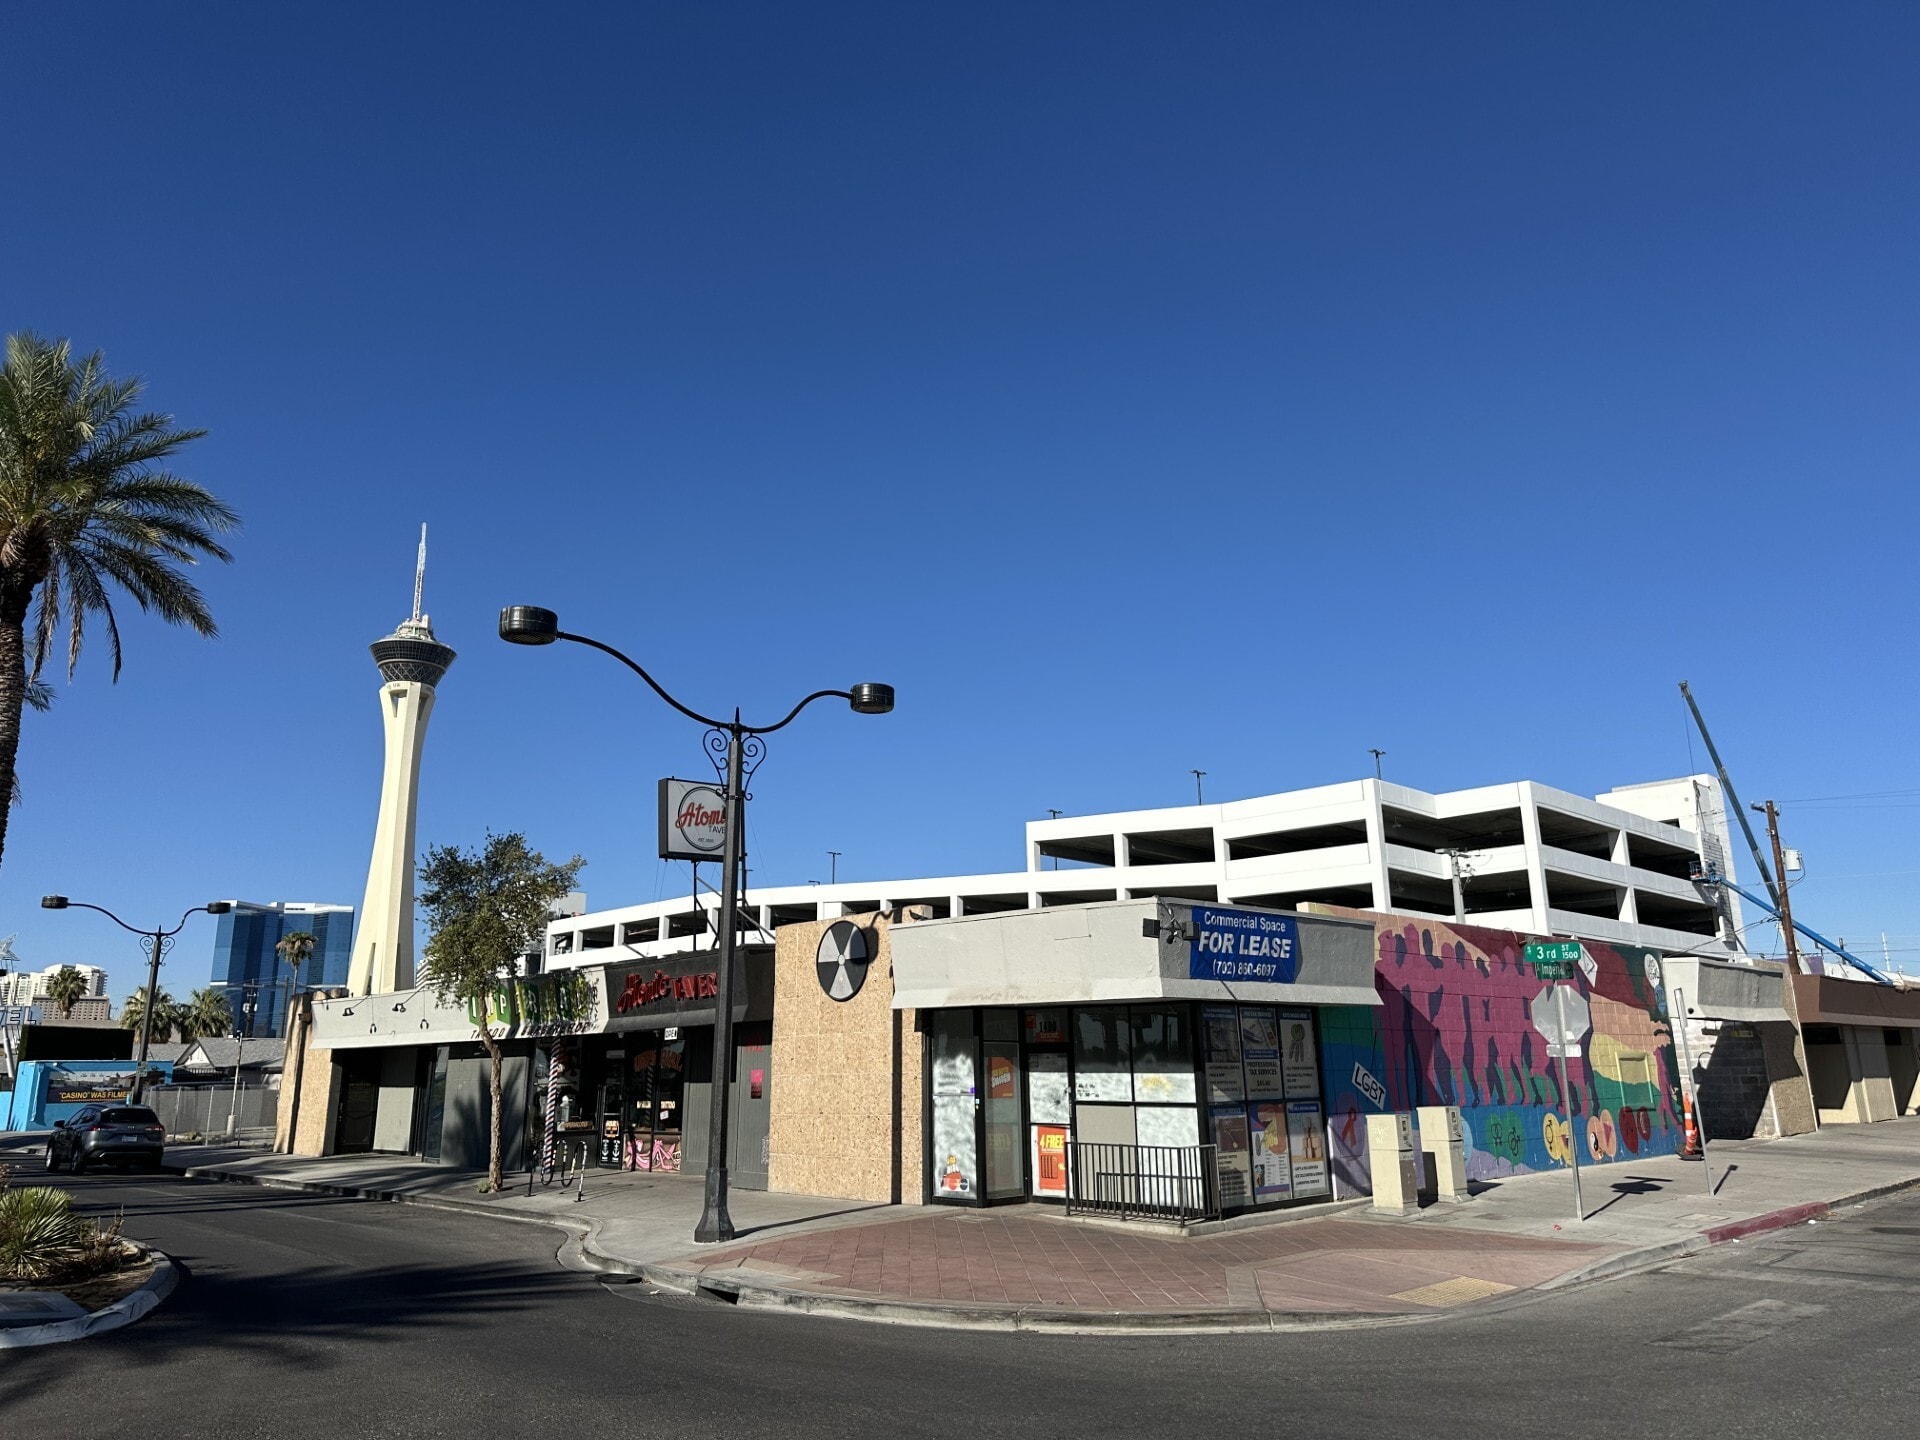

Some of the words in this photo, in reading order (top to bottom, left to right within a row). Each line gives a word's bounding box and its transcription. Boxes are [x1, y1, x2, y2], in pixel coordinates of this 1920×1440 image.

[675, 802, 727, 830] Atomi
[708, 826, 726, 834] TAVE
[1204, 911, 1258, 929] Commercial
[1259, 917, 1286, 933] Space
[1198, 930, 1235, 954] FOR
[1238, 934, 1292, 959] LEASE
[1526, 946, 1532, 954] S
[1561, 944, 1569, 952] ST
[1562, 951, 1579, 959] 1500
[1212, 959, 1236, 978] (702)
[671, 972, 718, 1000] TAVER
[1354, 1066, 1385, 1104] LGBT
[59, 1091, 90, 1099] "CASINO"
[91, 1091, 107, 1099] WAS
[108, 1091, 130, 1099] FILME
[1039, 1134, 1045, 1148] 4
[1045, 1134, 1065, 1149] FREE
